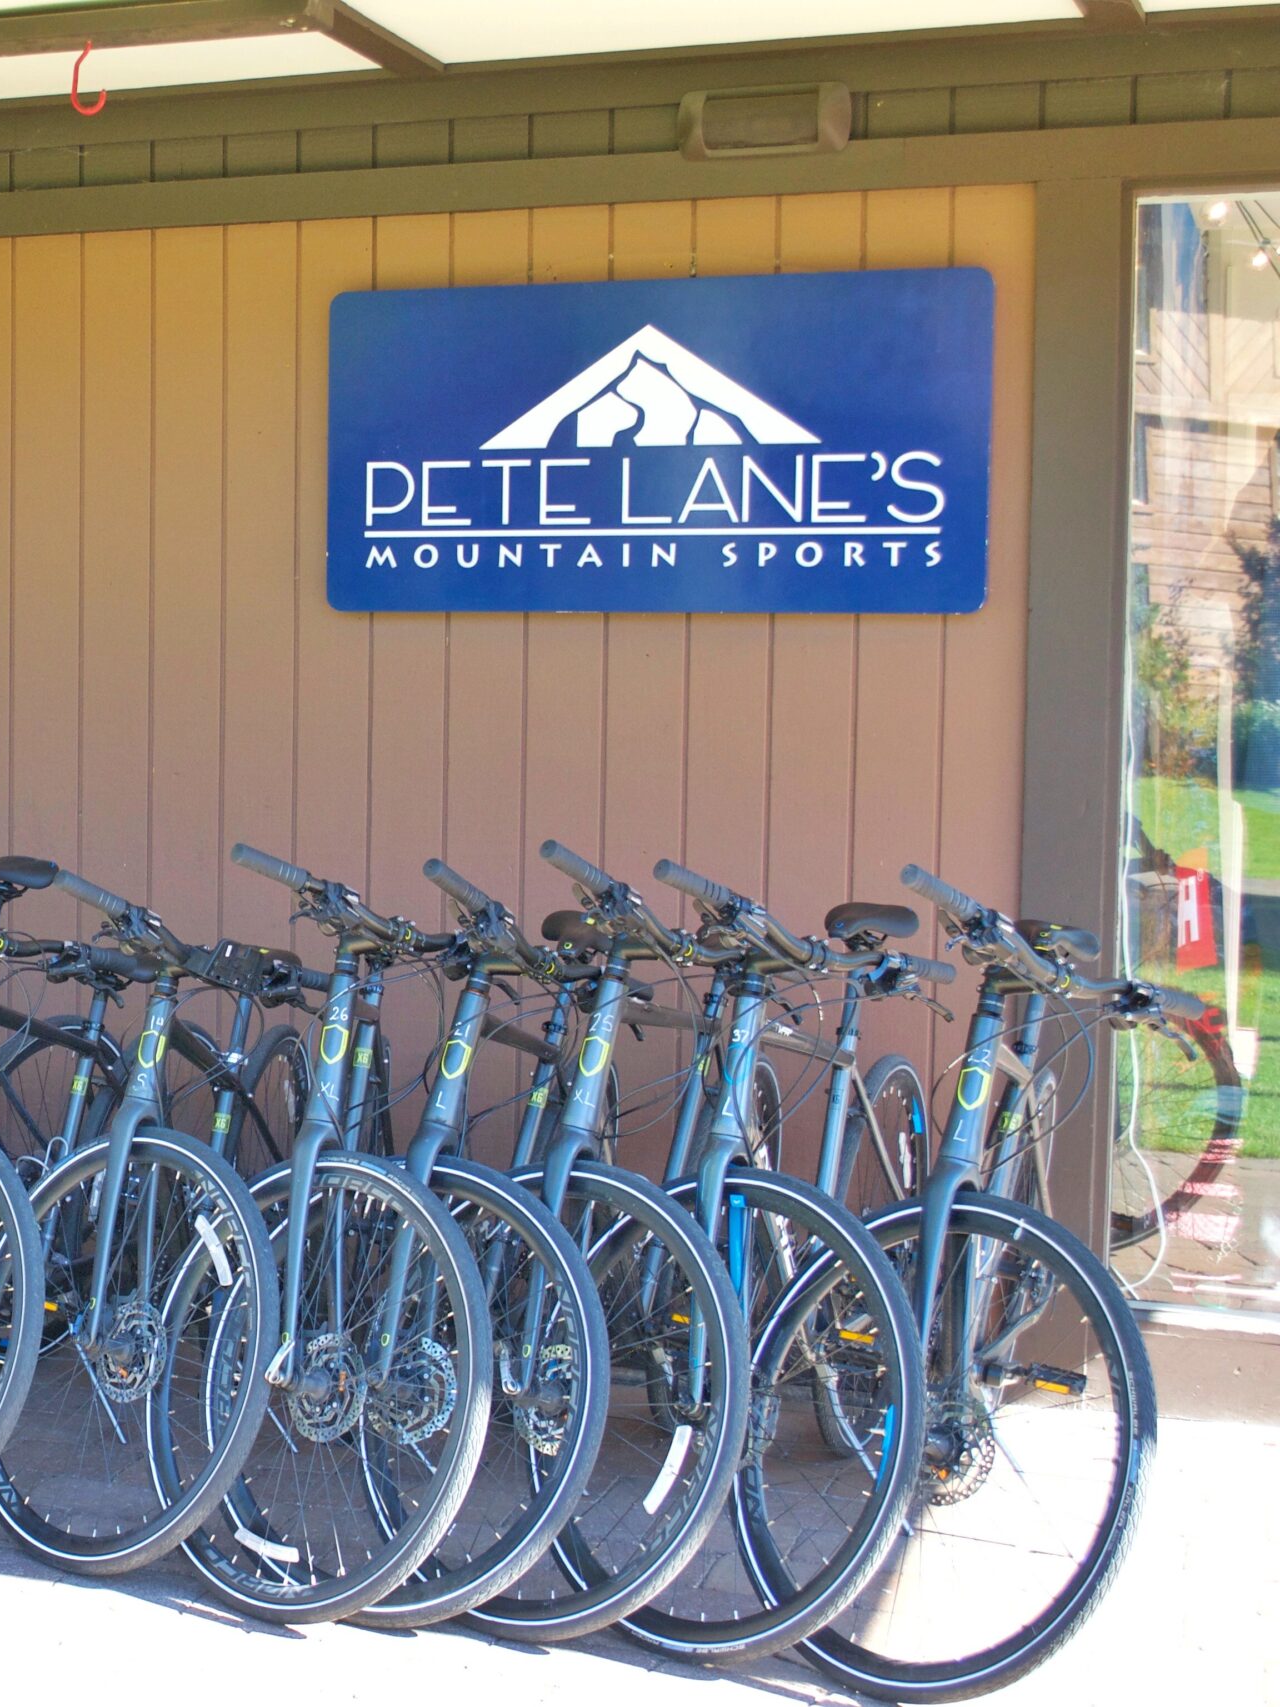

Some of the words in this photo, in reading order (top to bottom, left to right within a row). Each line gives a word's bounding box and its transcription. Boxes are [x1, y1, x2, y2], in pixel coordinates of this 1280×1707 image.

[365, 458, 591, 527] PETE
[621, 451, 946, 525] LANE'S
[365, 542, 677, 569] MOUNTAIN
[721, 539, 943, 568] SPORTS
[329, 1006, 349, 1022] 26
[588, 1011, 615, 1033] 25
[731, 1028, 749, 1043] 37
[356, 1052, 369, 1063] X6
[320, 1080, 340, 1101] XL
[435, 1090, 447, 1109] L
[572, 1088, 596, 1108] XL
[721, 1096, 735, 1117] L
[214, 1117, 226, 1130] X6
[952, 1119, 968, 1143] L
